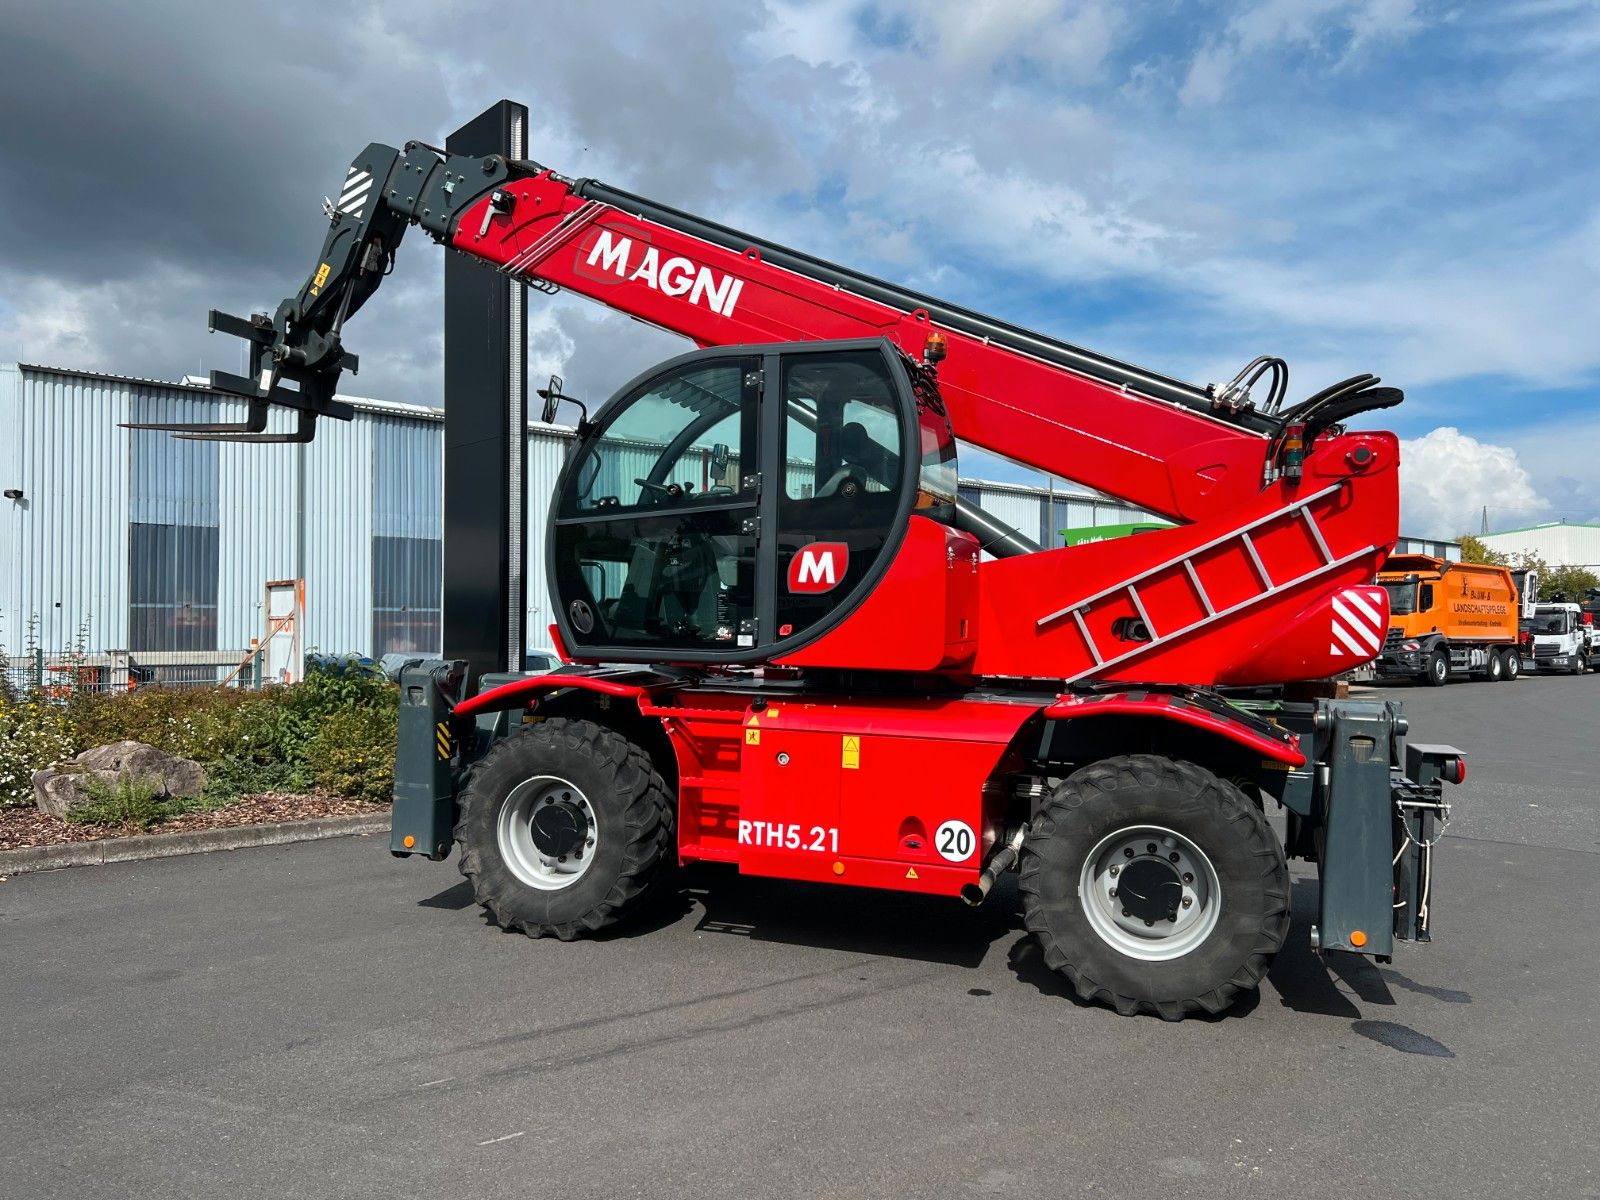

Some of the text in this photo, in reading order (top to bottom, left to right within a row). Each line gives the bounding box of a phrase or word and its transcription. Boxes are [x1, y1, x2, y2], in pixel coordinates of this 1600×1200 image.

[586, 230, 744, 318] MAGNI
[797, 551, 835, 584] M
[1453, 603, 1507, 615] LANDSCHAFTSPFLEGE
[738, 819, 839, 853] RTH5.21
[940, 827, 970, 855] 20
